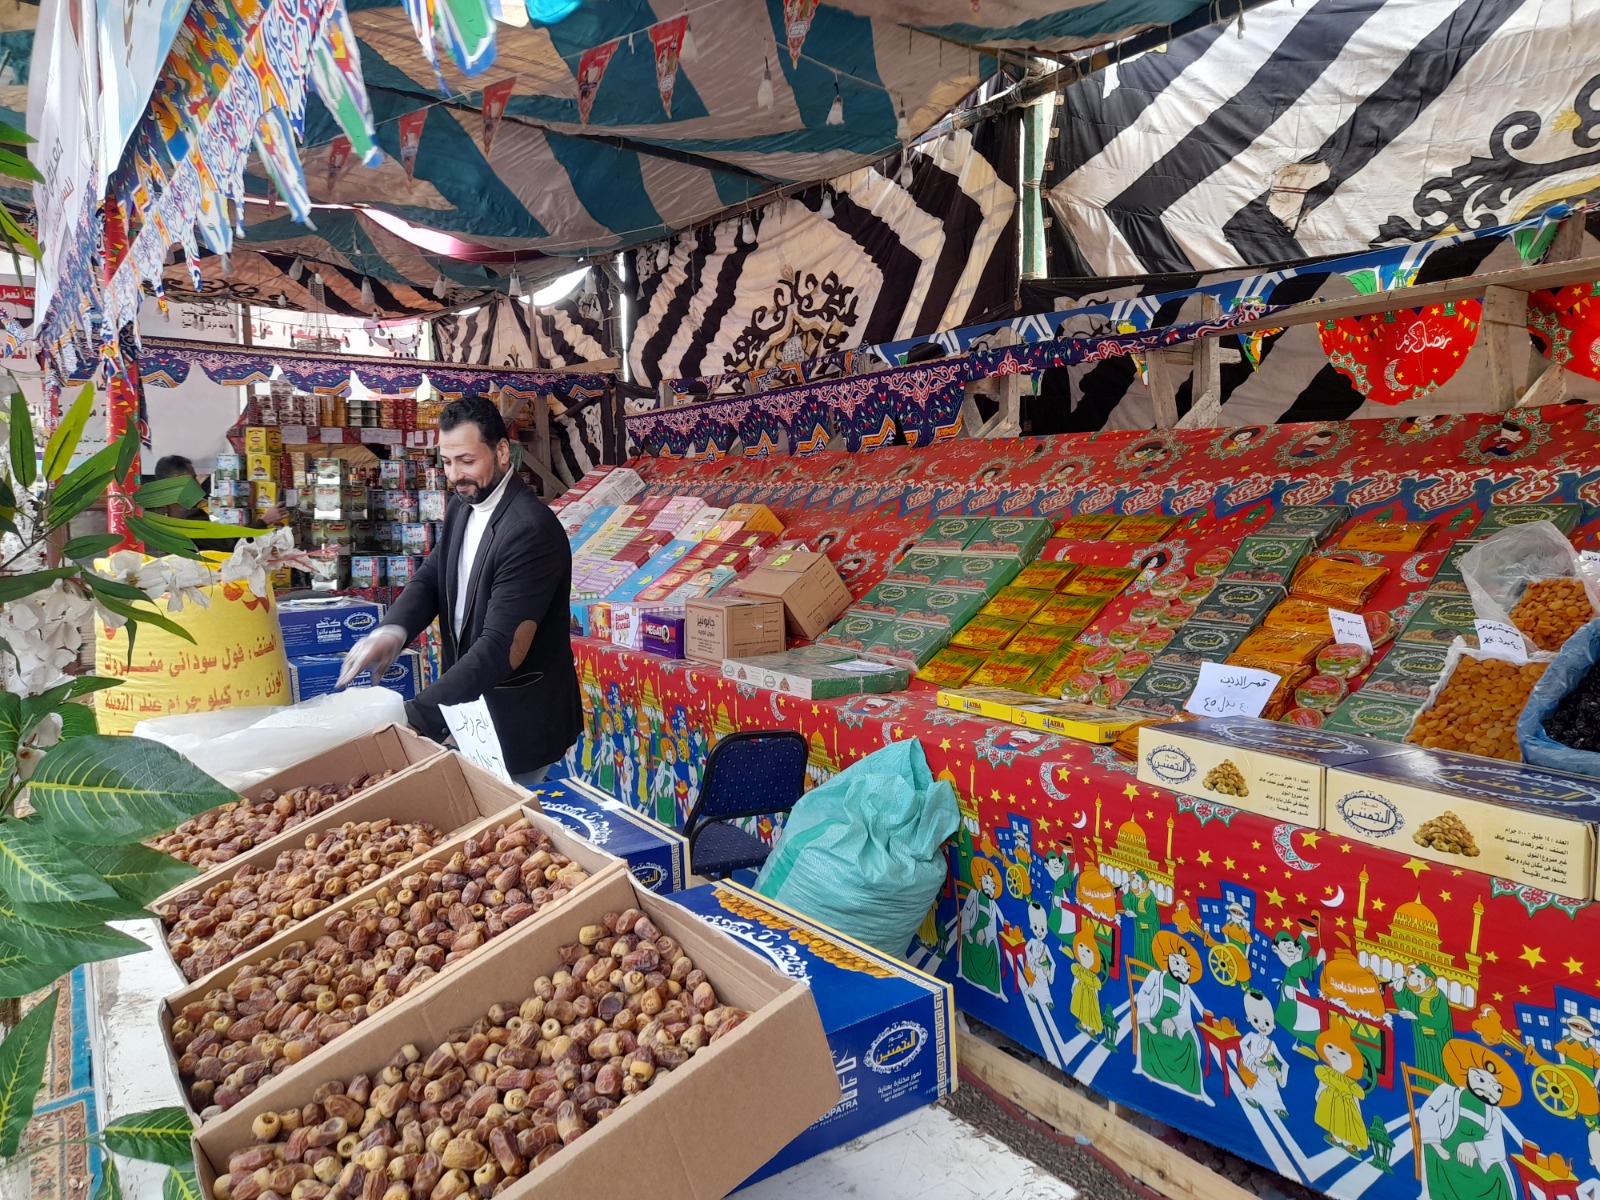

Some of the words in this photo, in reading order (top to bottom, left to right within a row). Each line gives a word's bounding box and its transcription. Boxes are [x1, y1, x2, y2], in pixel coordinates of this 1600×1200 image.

[1152, 757, 1187, 774] النجمتين
[1346, 804, 1391, 826] النجمتين
[875, 1030, 917, 1065] النجمتين
